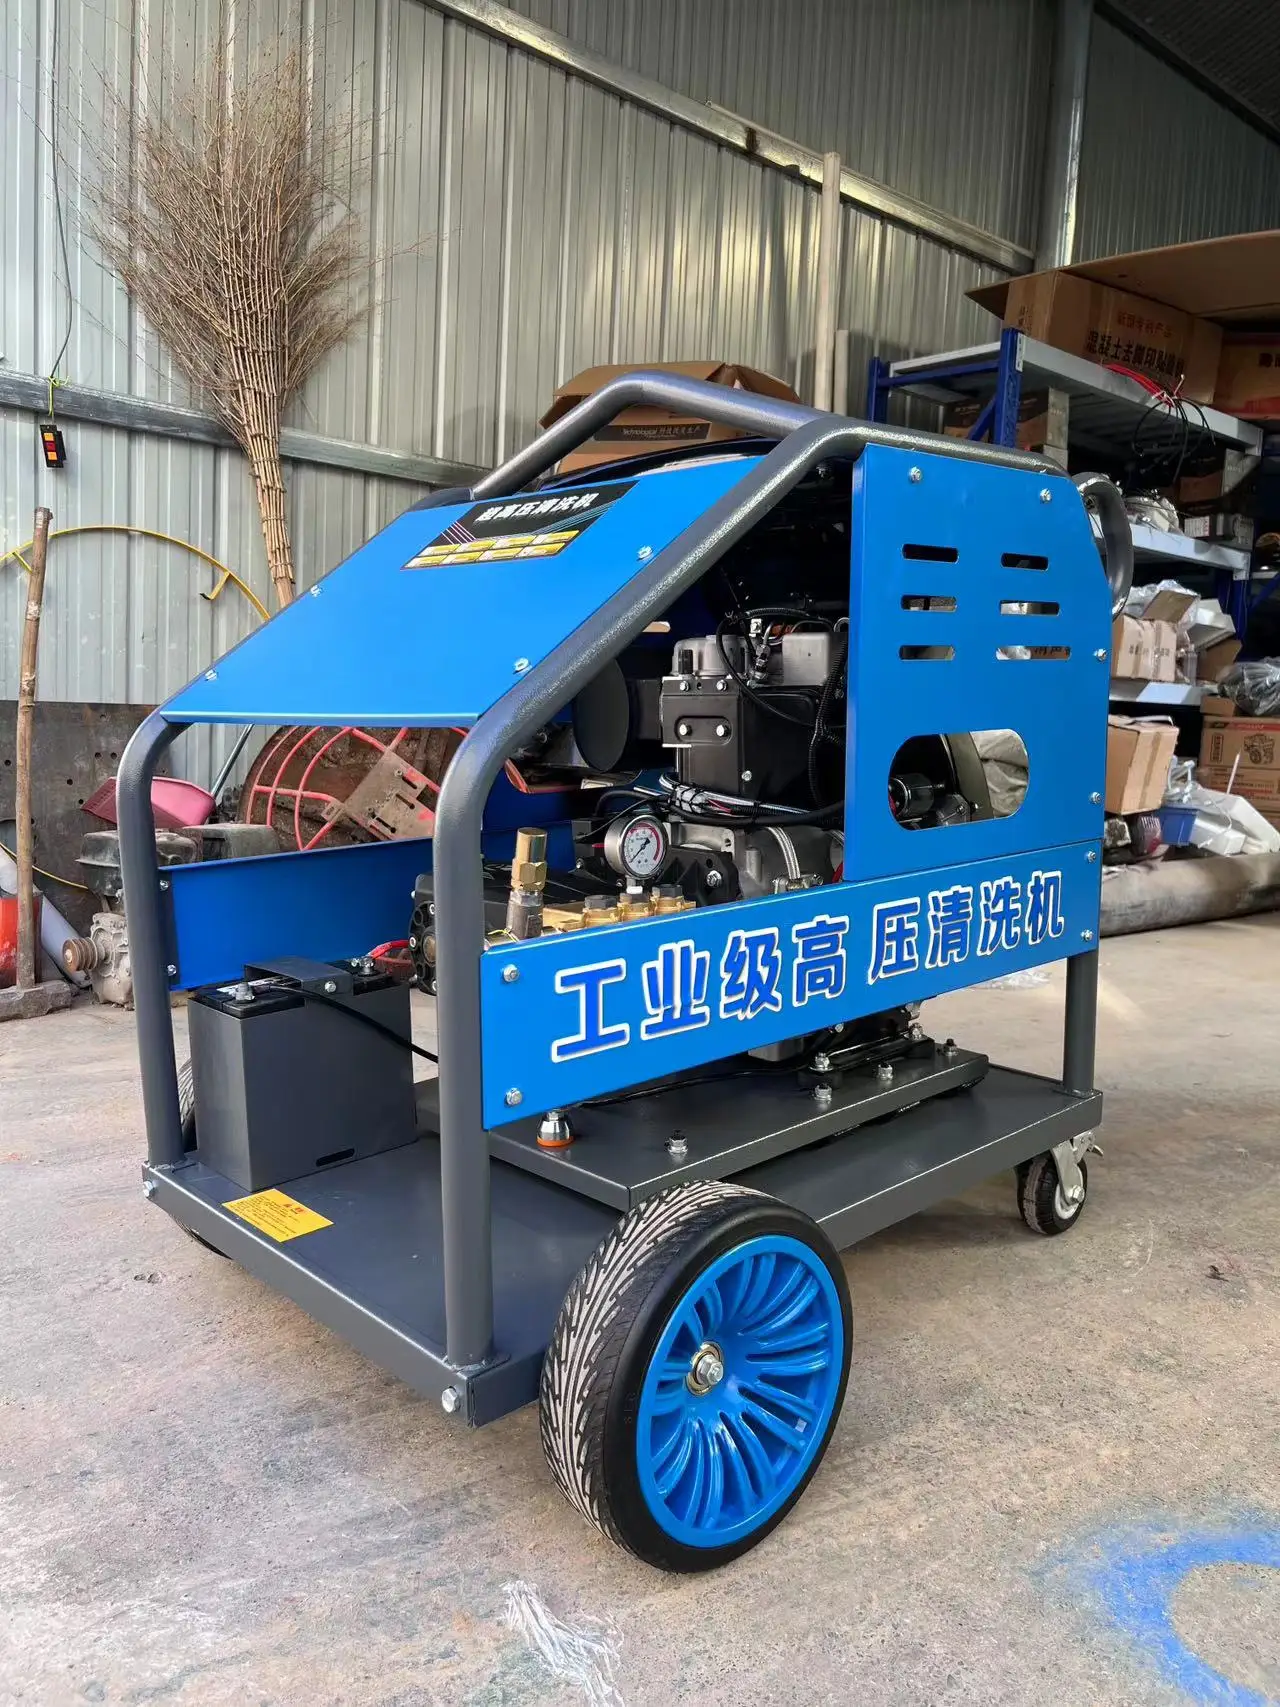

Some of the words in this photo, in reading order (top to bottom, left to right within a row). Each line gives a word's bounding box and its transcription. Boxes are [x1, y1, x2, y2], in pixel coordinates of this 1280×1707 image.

[551, 871, 1065, 1062] 工业级高压清洗机
